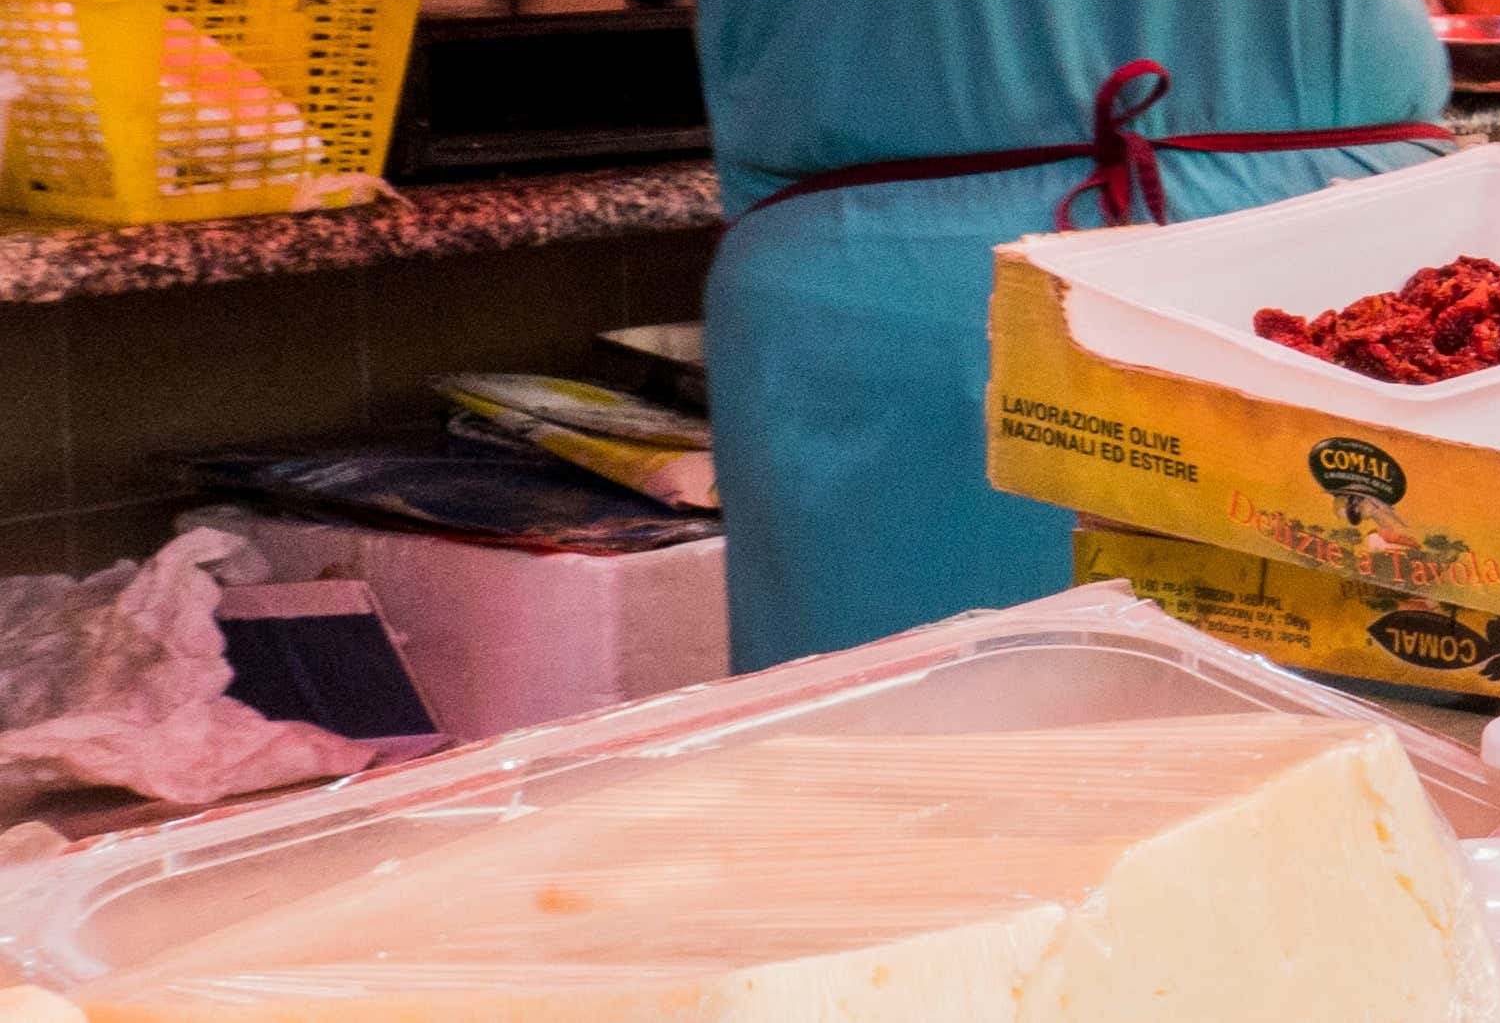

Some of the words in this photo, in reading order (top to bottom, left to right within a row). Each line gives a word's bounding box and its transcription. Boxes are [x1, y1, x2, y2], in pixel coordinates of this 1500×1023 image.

[1001, 417, 1096, 456] NAZIONALI
[1101, 442, 1124, 464] ED
[1130, 449, 1199, 484] ESTERE
[1002, 394, 1124, 441] LAVORAZIONE
[1129, 427, 1181, 456] OLIVE
[1320, 449, 1393, 484] COMAL
[1228, 489, 1345, 570] Delizie
[1356, 548, 1376, 576] a
[1389, 628, 1478, 664] COMAL
